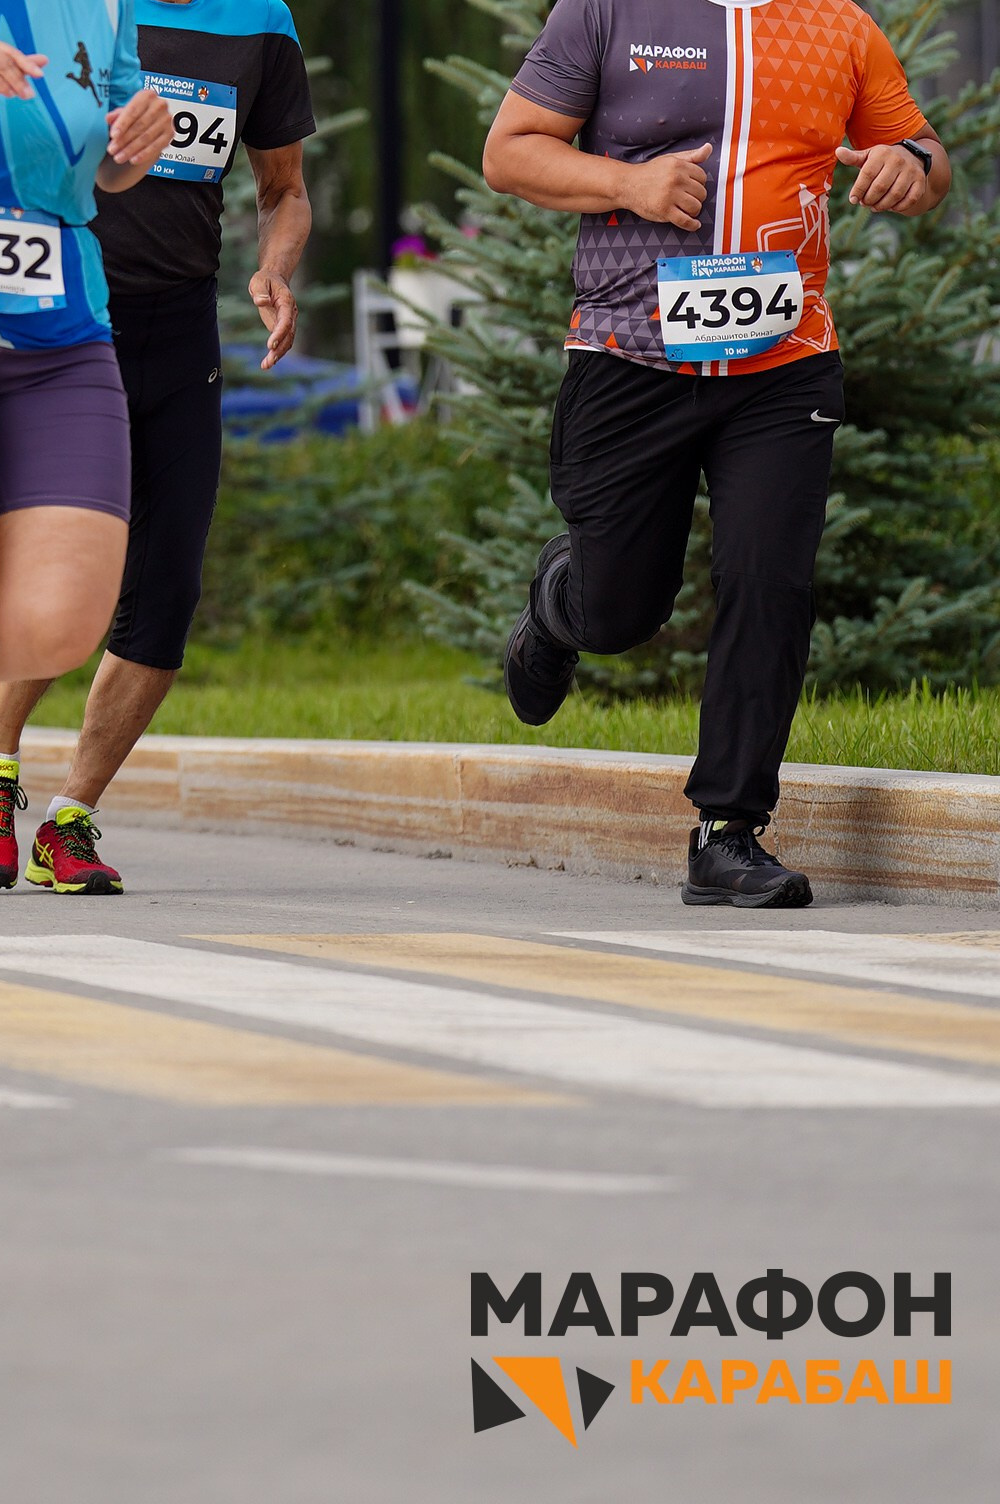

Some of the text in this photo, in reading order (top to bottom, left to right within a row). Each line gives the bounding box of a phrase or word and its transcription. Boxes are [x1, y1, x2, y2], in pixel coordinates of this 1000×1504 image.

[630, 43, 707, 59] МАРАФОН
[655, 59, 707, 70] КАРАБАШ
[150, 76, 195, 90] МАРАФОН
[164, 86, 194, 96] КАРАБАШ
[170, 111, 228, 154] 94
[175, 152, 196, 163] Юлай
[153, 164, 175, 175] 10 км
[697, 256, 746, 267] МАРАФОН
[713, 265, 747, 273] КАРАБАШ
[666, 283, 798, 329] 4394
[694, 329, 774, 343] Абдрашитов Ринат
[724, 347, 749, 356] 10 км
